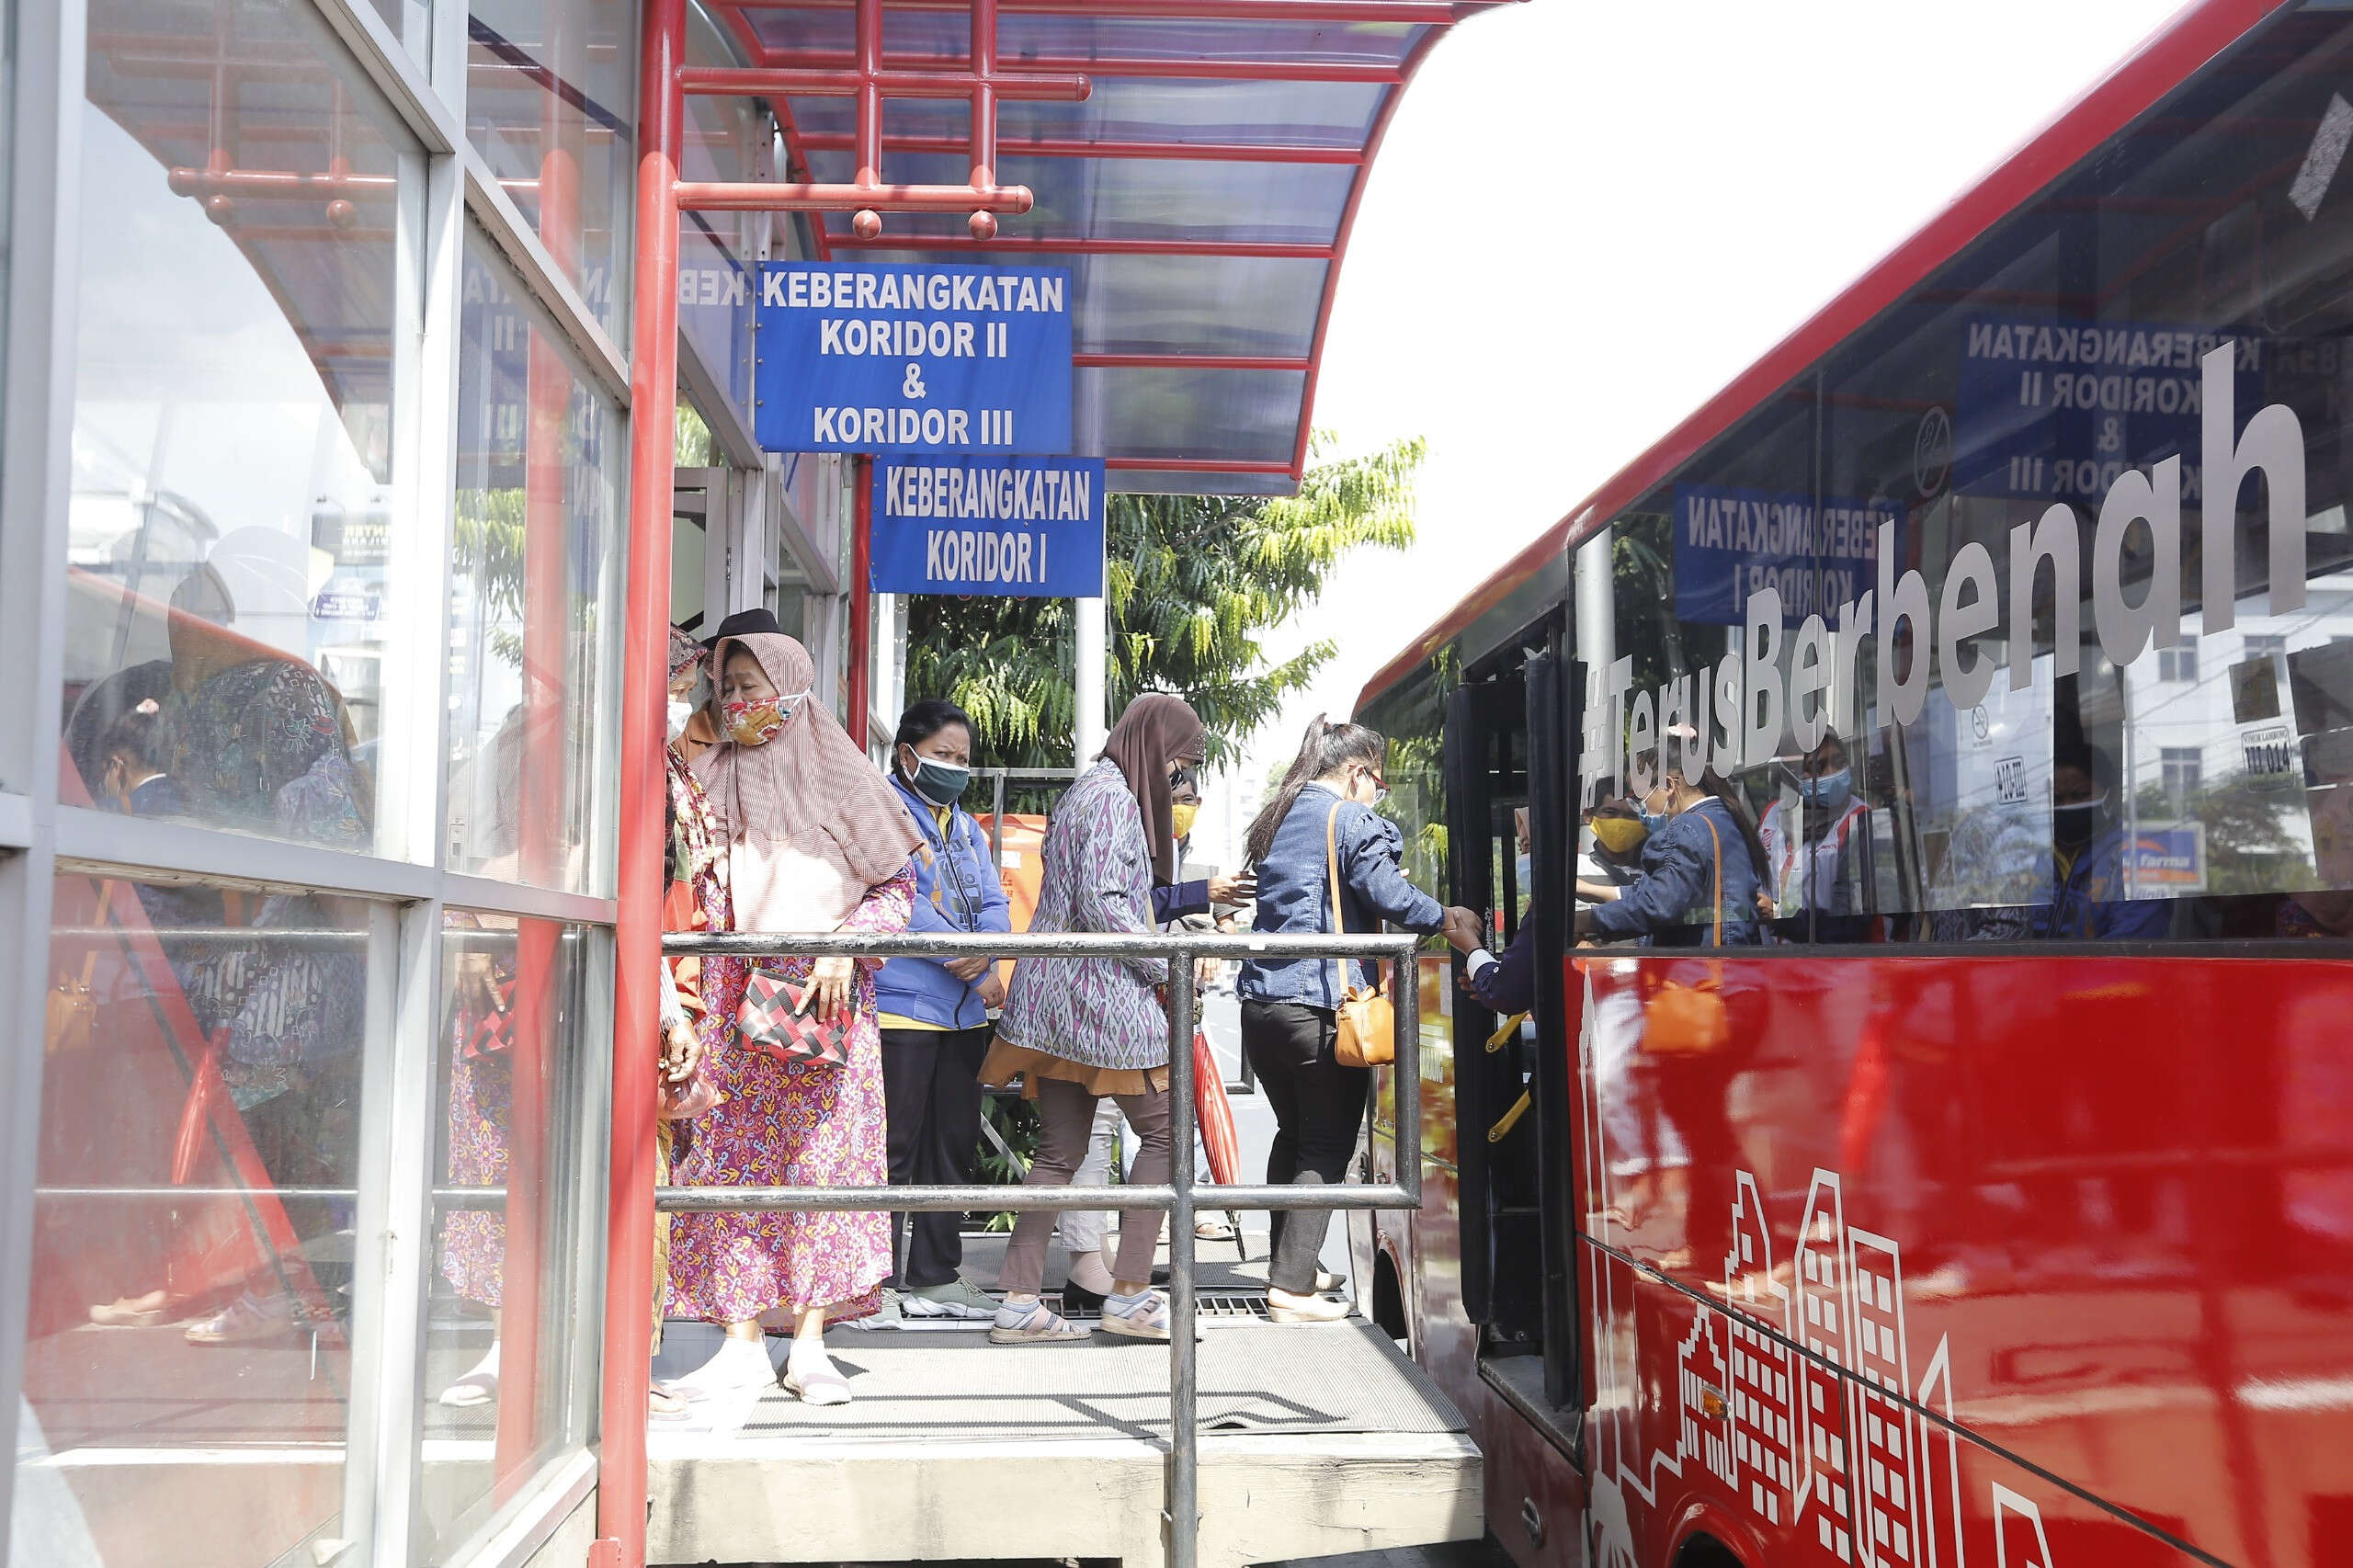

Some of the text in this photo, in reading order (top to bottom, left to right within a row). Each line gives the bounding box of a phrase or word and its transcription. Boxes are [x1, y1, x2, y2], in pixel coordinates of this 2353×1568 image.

[763, 270, 1063, 312] KEBERANGKATAN
[821, 319, 1006, 358] KORIDOR II
[903, 362, 926, 398] &
[813, 407, 1013, 446] KORIDOR III
[885, 466, 1090, 521] KEBERANGKATAN
[926, 529, 1046, 583] KORIDOR I
[1578, 340, 2306, 809] #TerusBerbenah
